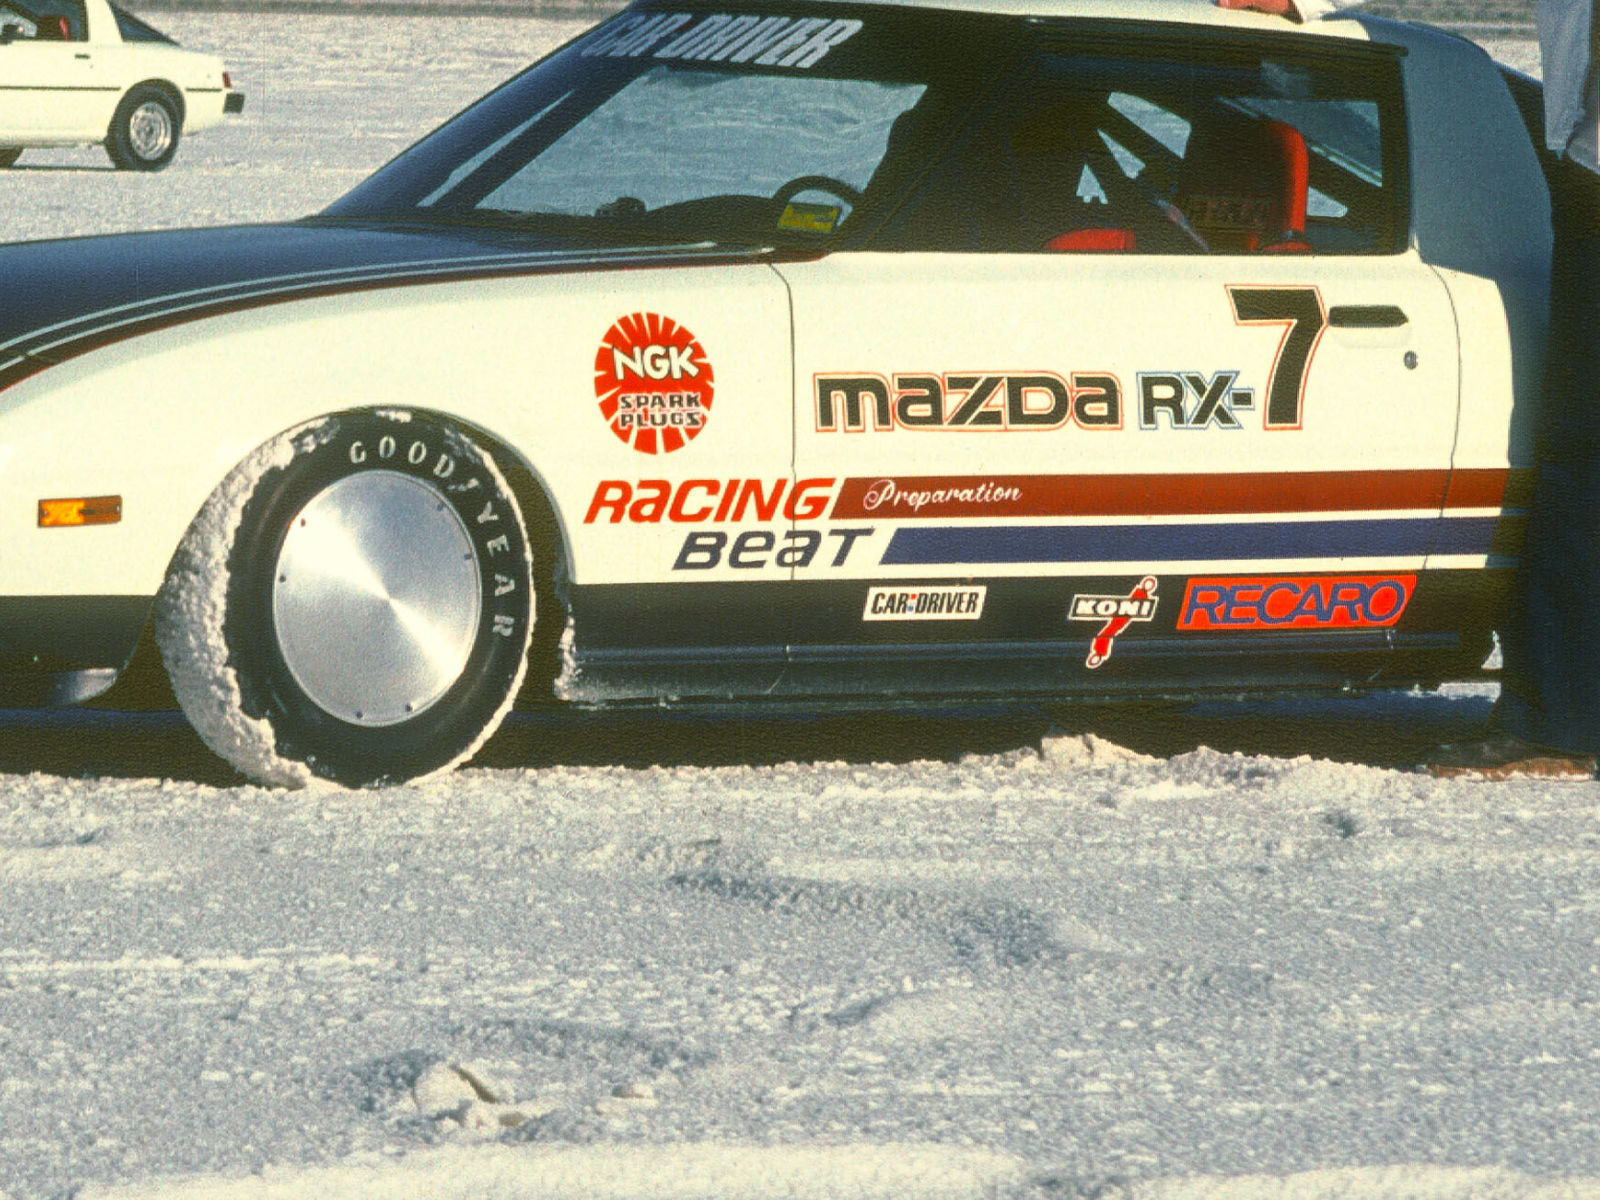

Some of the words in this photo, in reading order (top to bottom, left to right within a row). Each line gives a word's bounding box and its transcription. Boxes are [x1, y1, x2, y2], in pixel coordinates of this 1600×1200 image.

[652, 12, 864, 69] DRIVER
[611, 343, 700, 381] NGK
[618, 392, 702, 409] SPARK
[618, 409, 703, 428] PLUGS
[863, 478, 1023, 512] Preparation
[349, 435, 515, 639] GOODYEAR
[1074, 599, 1151, 617] KONI
[1182, 580, 1406, 625] RECARO
